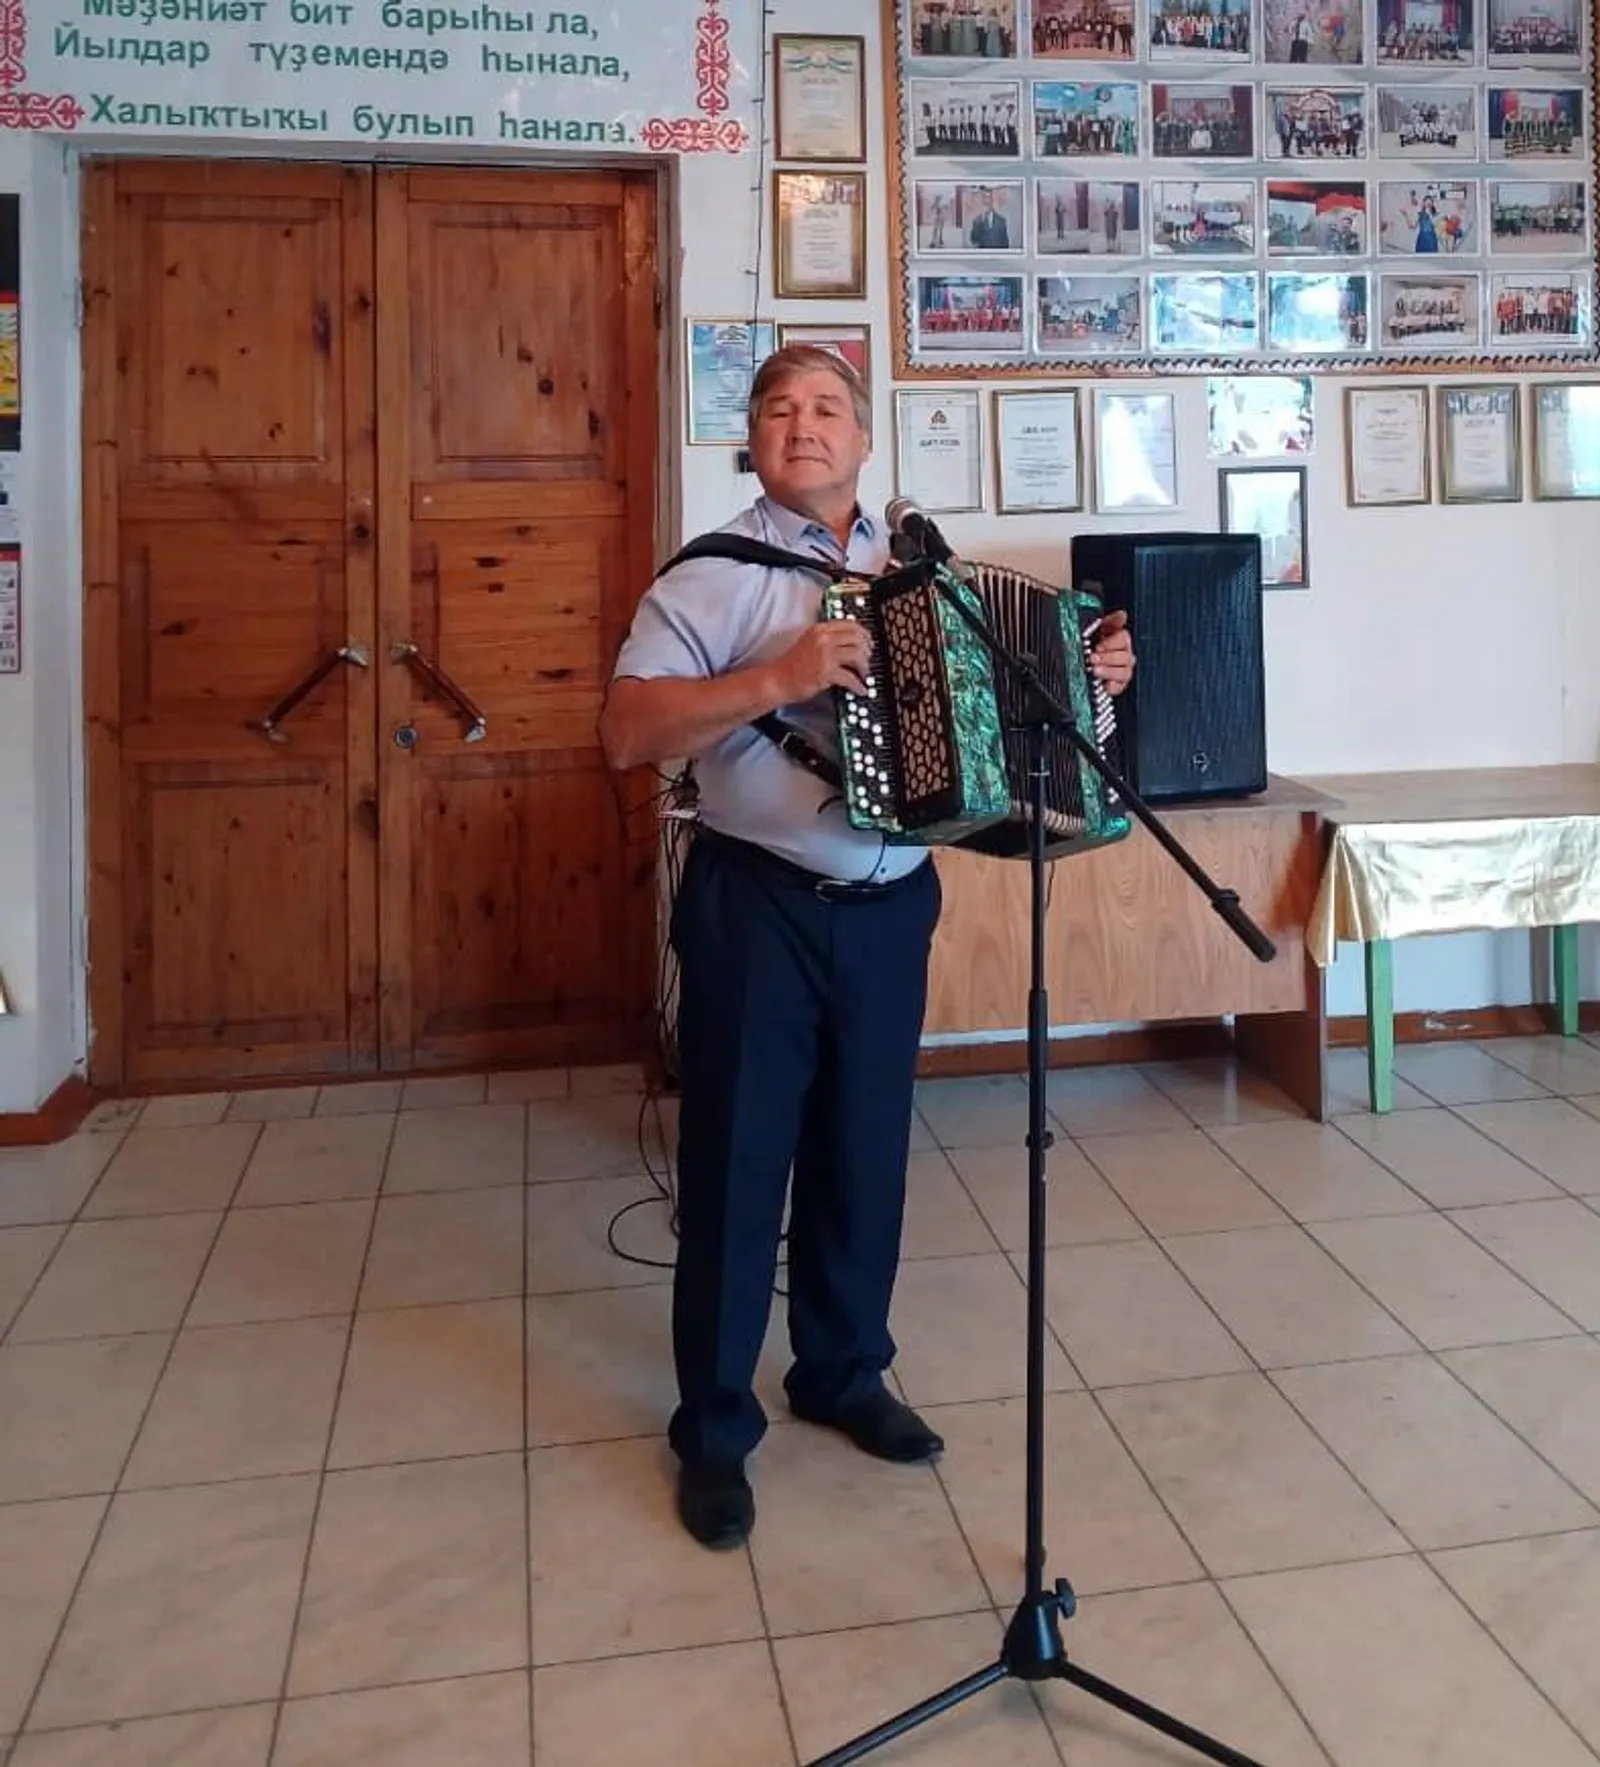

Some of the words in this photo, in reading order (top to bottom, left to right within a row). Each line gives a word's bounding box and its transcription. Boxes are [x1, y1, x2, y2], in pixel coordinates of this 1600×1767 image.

[290, 0, 353, 25] бит
[381, 0, 533, 36] барыһы
[546, 12, 598, 40] ла,
[54, 21, 210, 68] Йылдар
[248, 42, 449, 74] түҙемендә
[481, 44, 630, 82] һынала,
[90, 93, 328, 131] Халыҡтыҡы
[353, 104, 474, 140] булып
